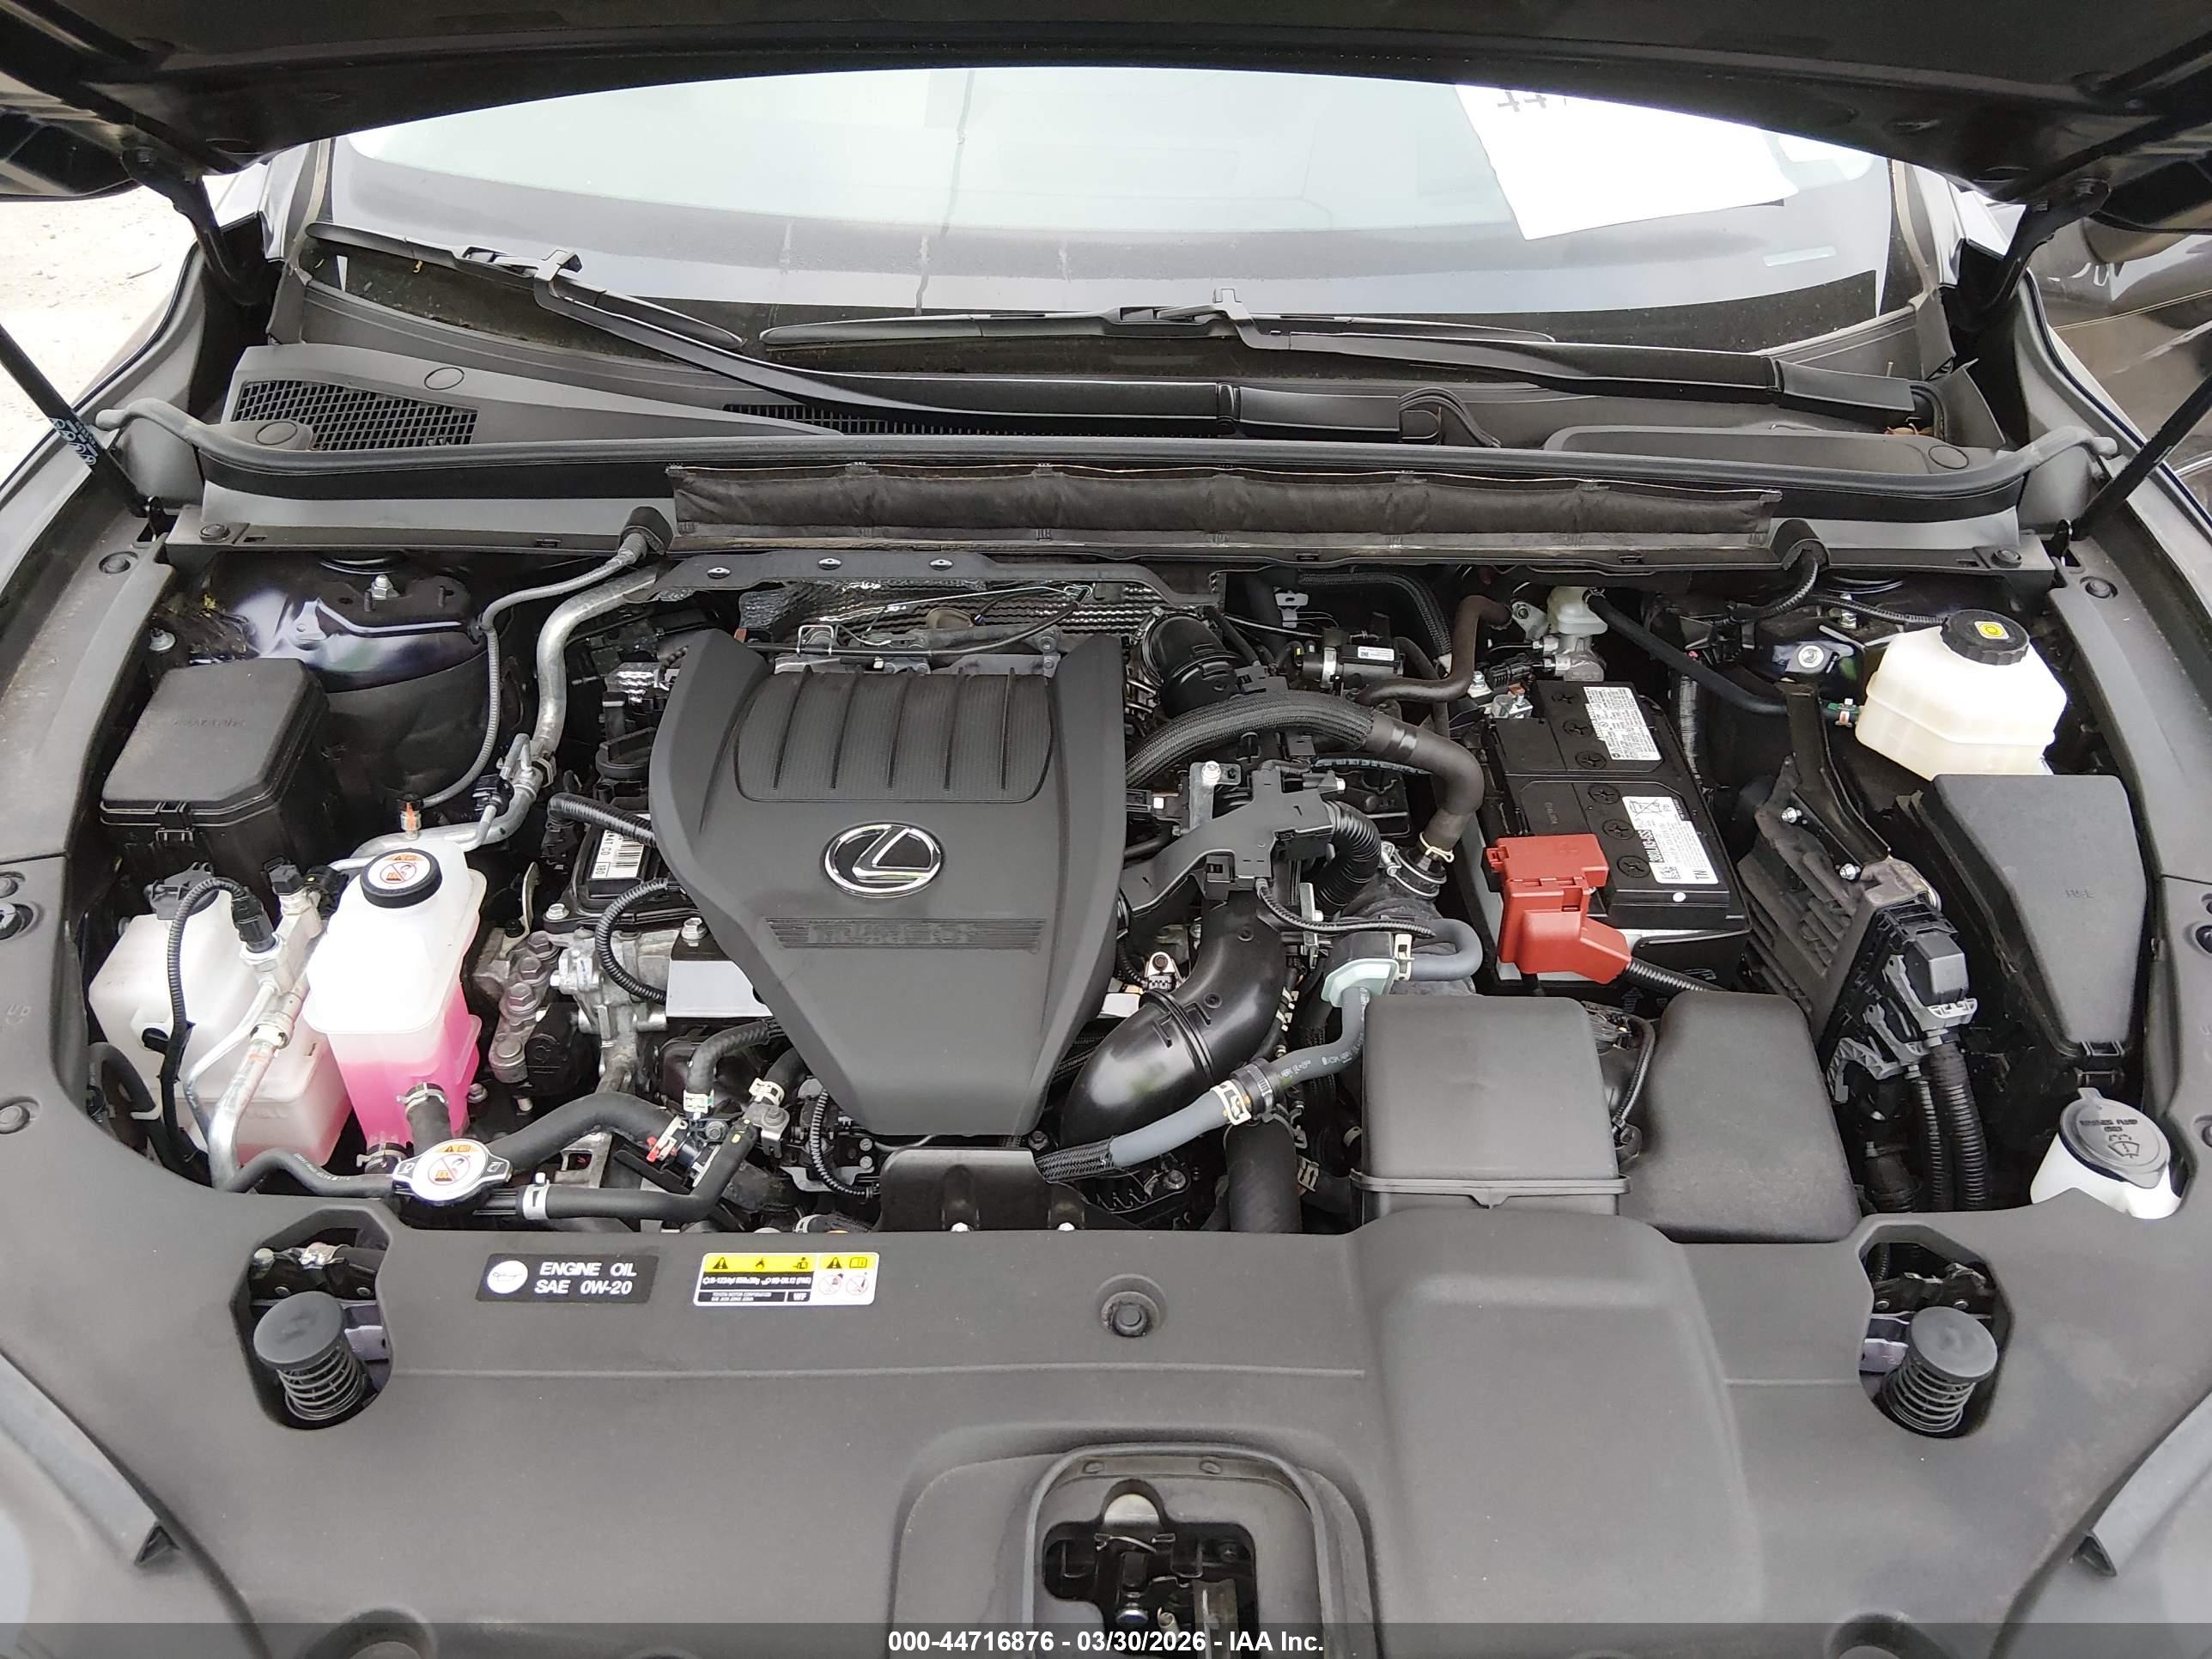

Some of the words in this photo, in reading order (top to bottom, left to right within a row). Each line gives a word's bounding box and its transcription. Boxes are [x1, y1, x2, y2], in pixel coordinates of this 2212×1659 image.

[539, 1261, 602, 1277] ENGINE
[610, 1262, 637, 1277] OIL
[534, 1279, 571, 1294] SAE
[580, 1279, 633, 1295] 0W-20
